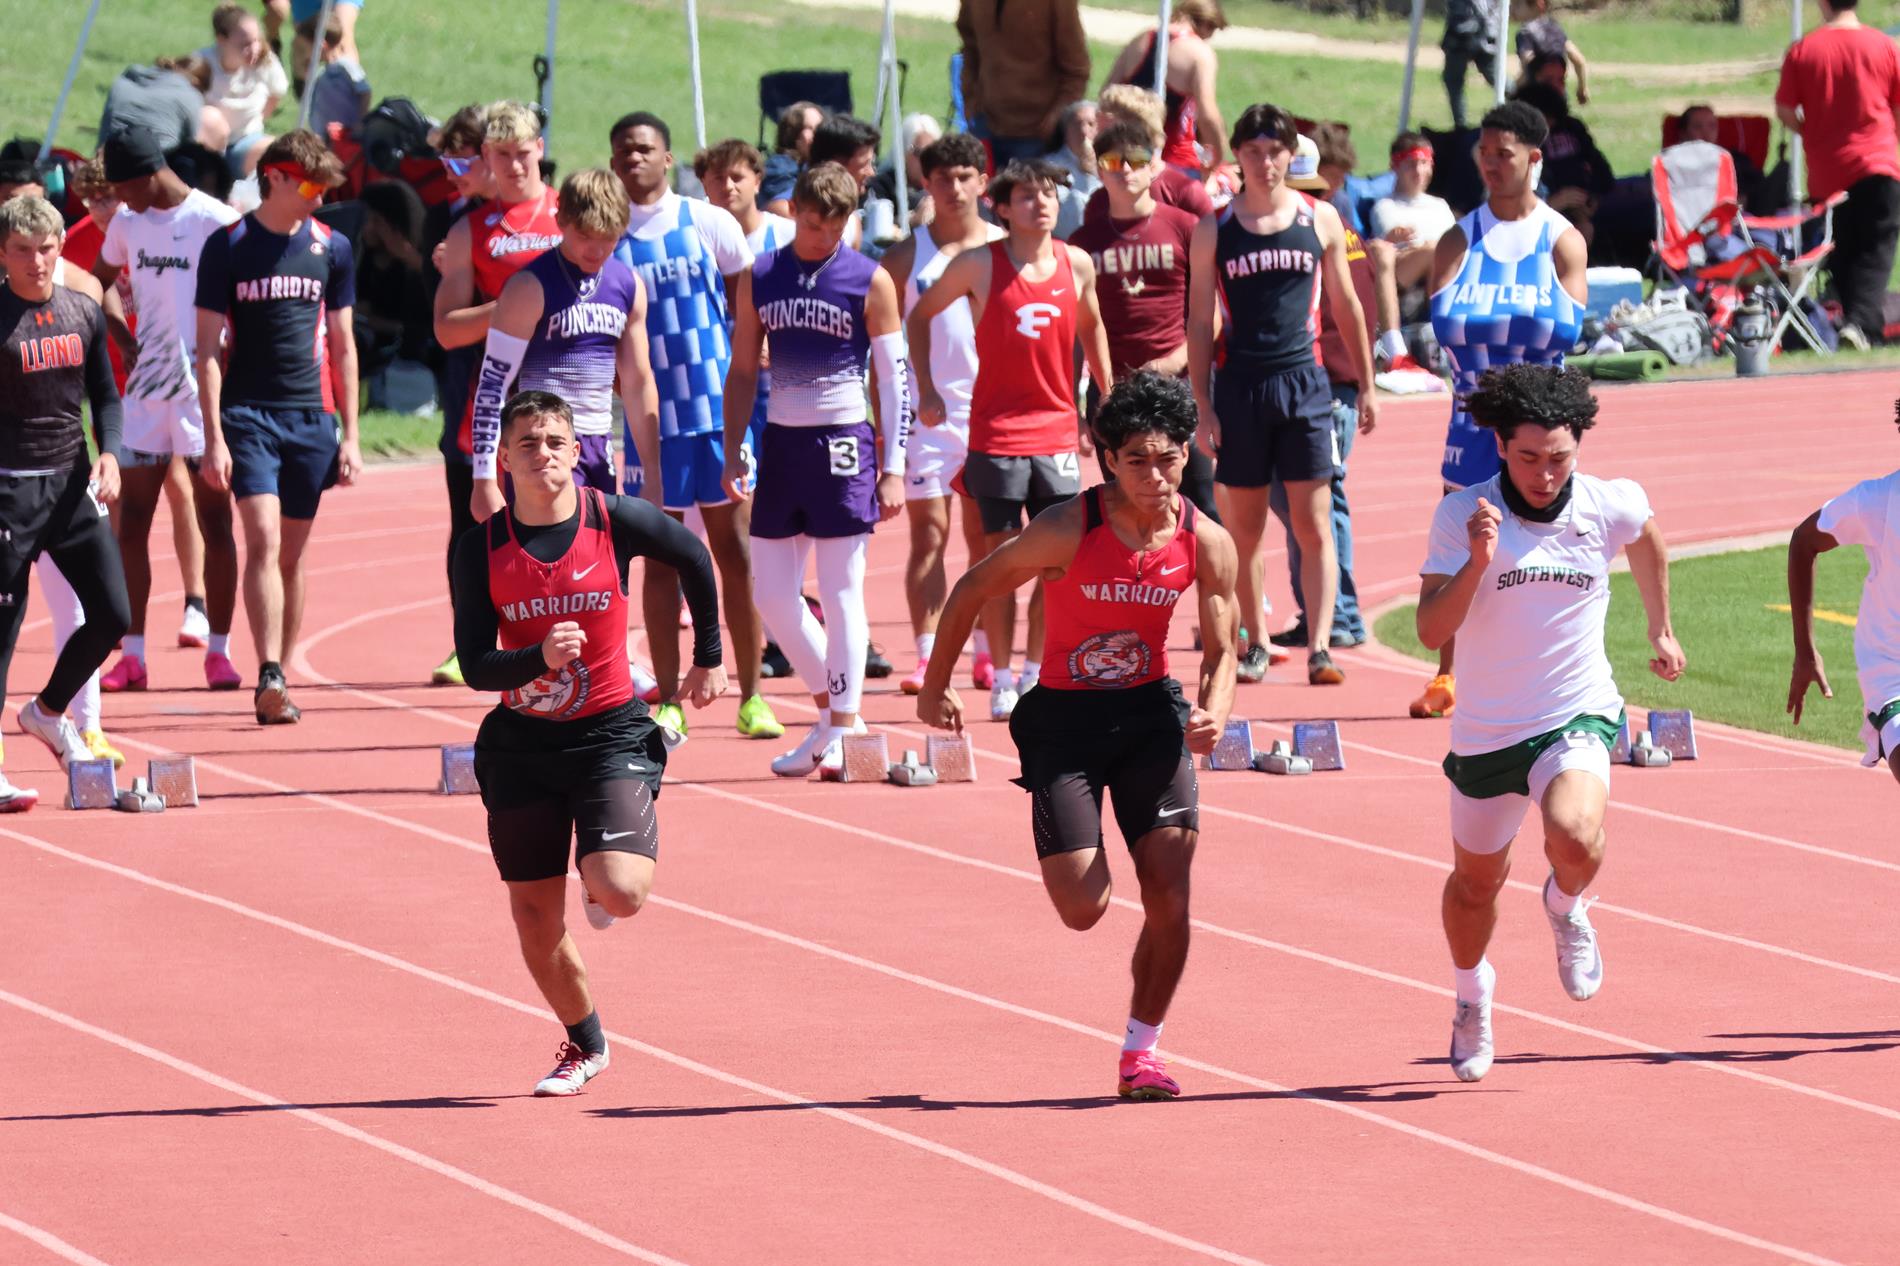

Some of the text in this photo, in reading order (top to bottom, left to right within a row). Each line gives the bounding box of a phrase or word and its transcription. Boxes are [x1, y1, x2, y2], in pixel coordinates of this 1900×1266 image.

[637, 254, 702, 285] TLERS
[1225, 249, 1314, 280] PATRIOTS
[236, 275, 323, 301] PATRIOTS
[20, 333, 84, 374] LLANO
[472, 354, 512, 455] PUNCHERS
[833, 440, 857, 470] 3
[1497, 565, 1594, 591] SOUTHWEST
[501, 590, 612, 622] WARRIORS
